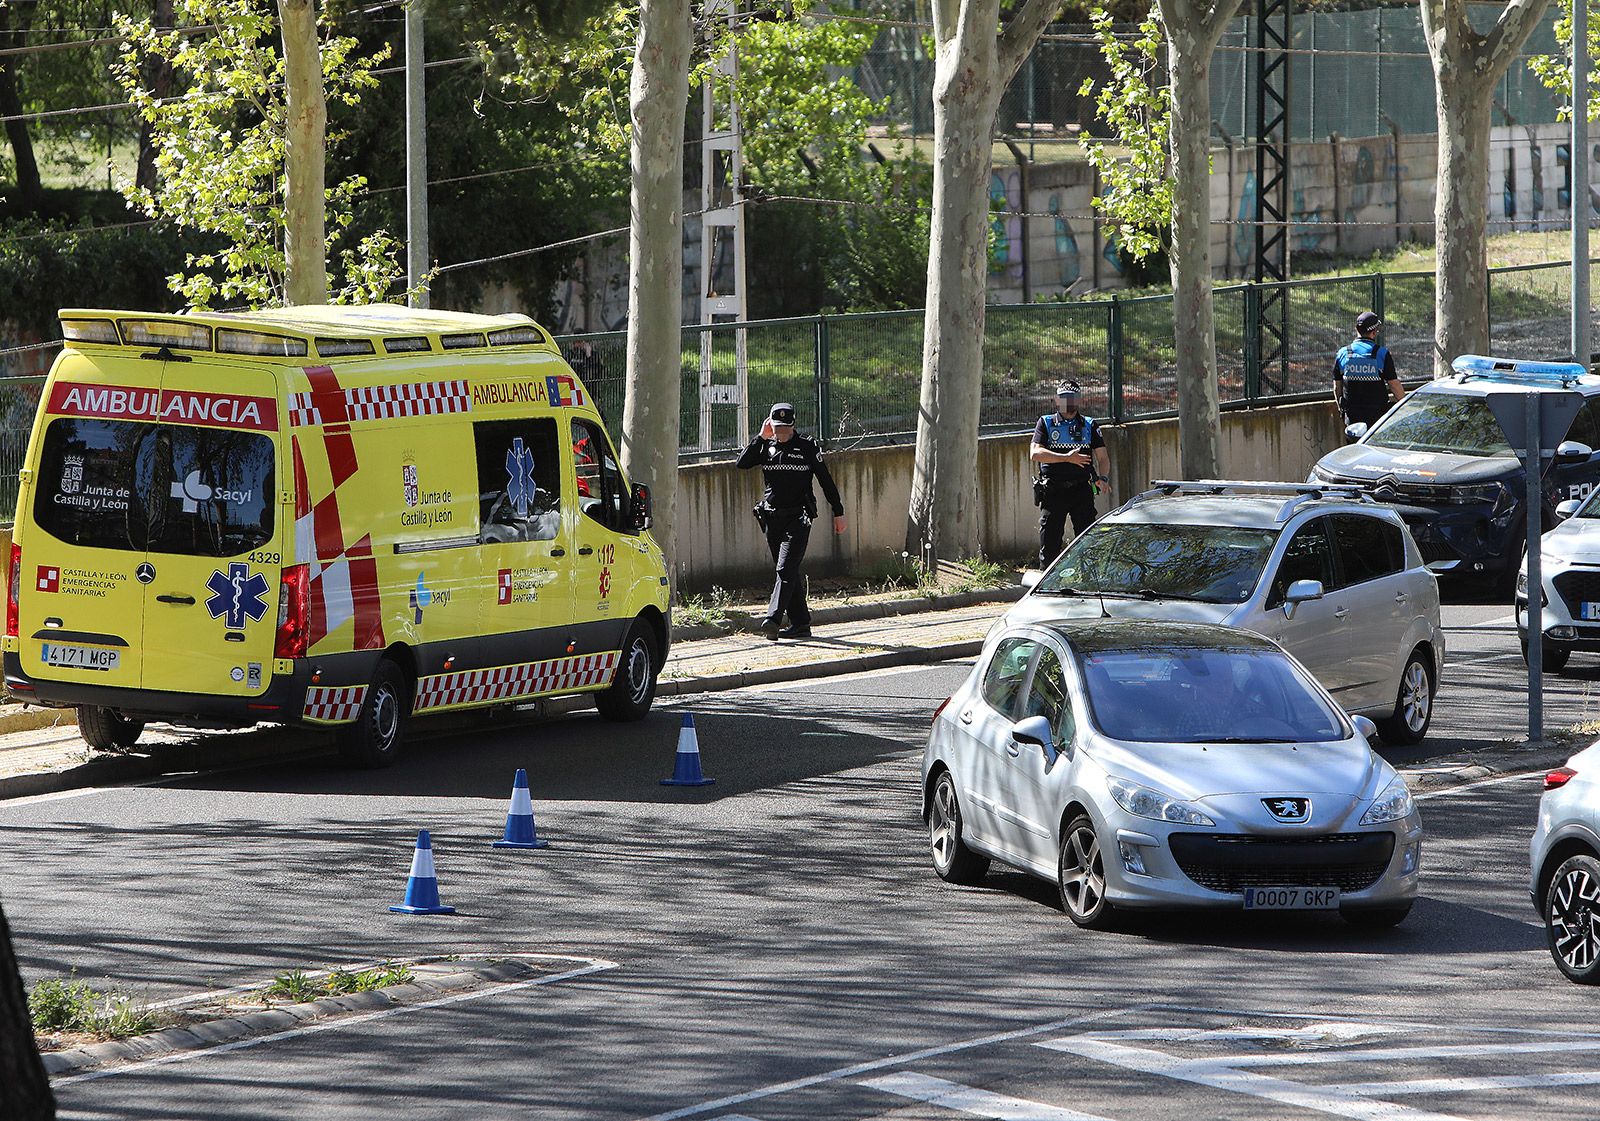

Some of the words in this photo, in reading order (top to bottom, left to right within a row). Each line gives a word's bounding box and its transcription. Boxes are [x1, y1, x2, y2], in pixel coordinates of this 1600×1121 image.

[1344, 364, 1376, 374] POLICÍA
[473, 382, 547, 405] AMBULANCIA
[61, 388, 262, 425] AMBULANCIA
[83, 484, 113, 496] Junta
[116, 487, 130, 498] de
[214, 487, 252, 505] Sacyl
[420, 490, 441, 505] Junta
[442, 489, 452, 503] de
[53, 493, 90, 506] Castilla
[92, 499, 100, 510] y
[102, 498, 129, 510] León
[401, 510, 427, 526] Castilla
[428, 513, 434, 528] y
[434, 508, 453, 522] León
[248, 551, 281, 564] 4329
[601, 543, 615, 565] 112
[63, 569, 98, 578] CASTILLA
[105, 572, 127, 581] LEÓN
[62, 578, 116, 590] EMERGENCIAS
[61, 587, 106, 598] SANITARIAS
[431, 587, 451, 607] Sacyl
[50, 647, 84, 663] 4171
[90, 650, 117, 666] MGP
[1256, 890, 1298, 906] 0007
[1304, 890, 1335, 906] GKP
